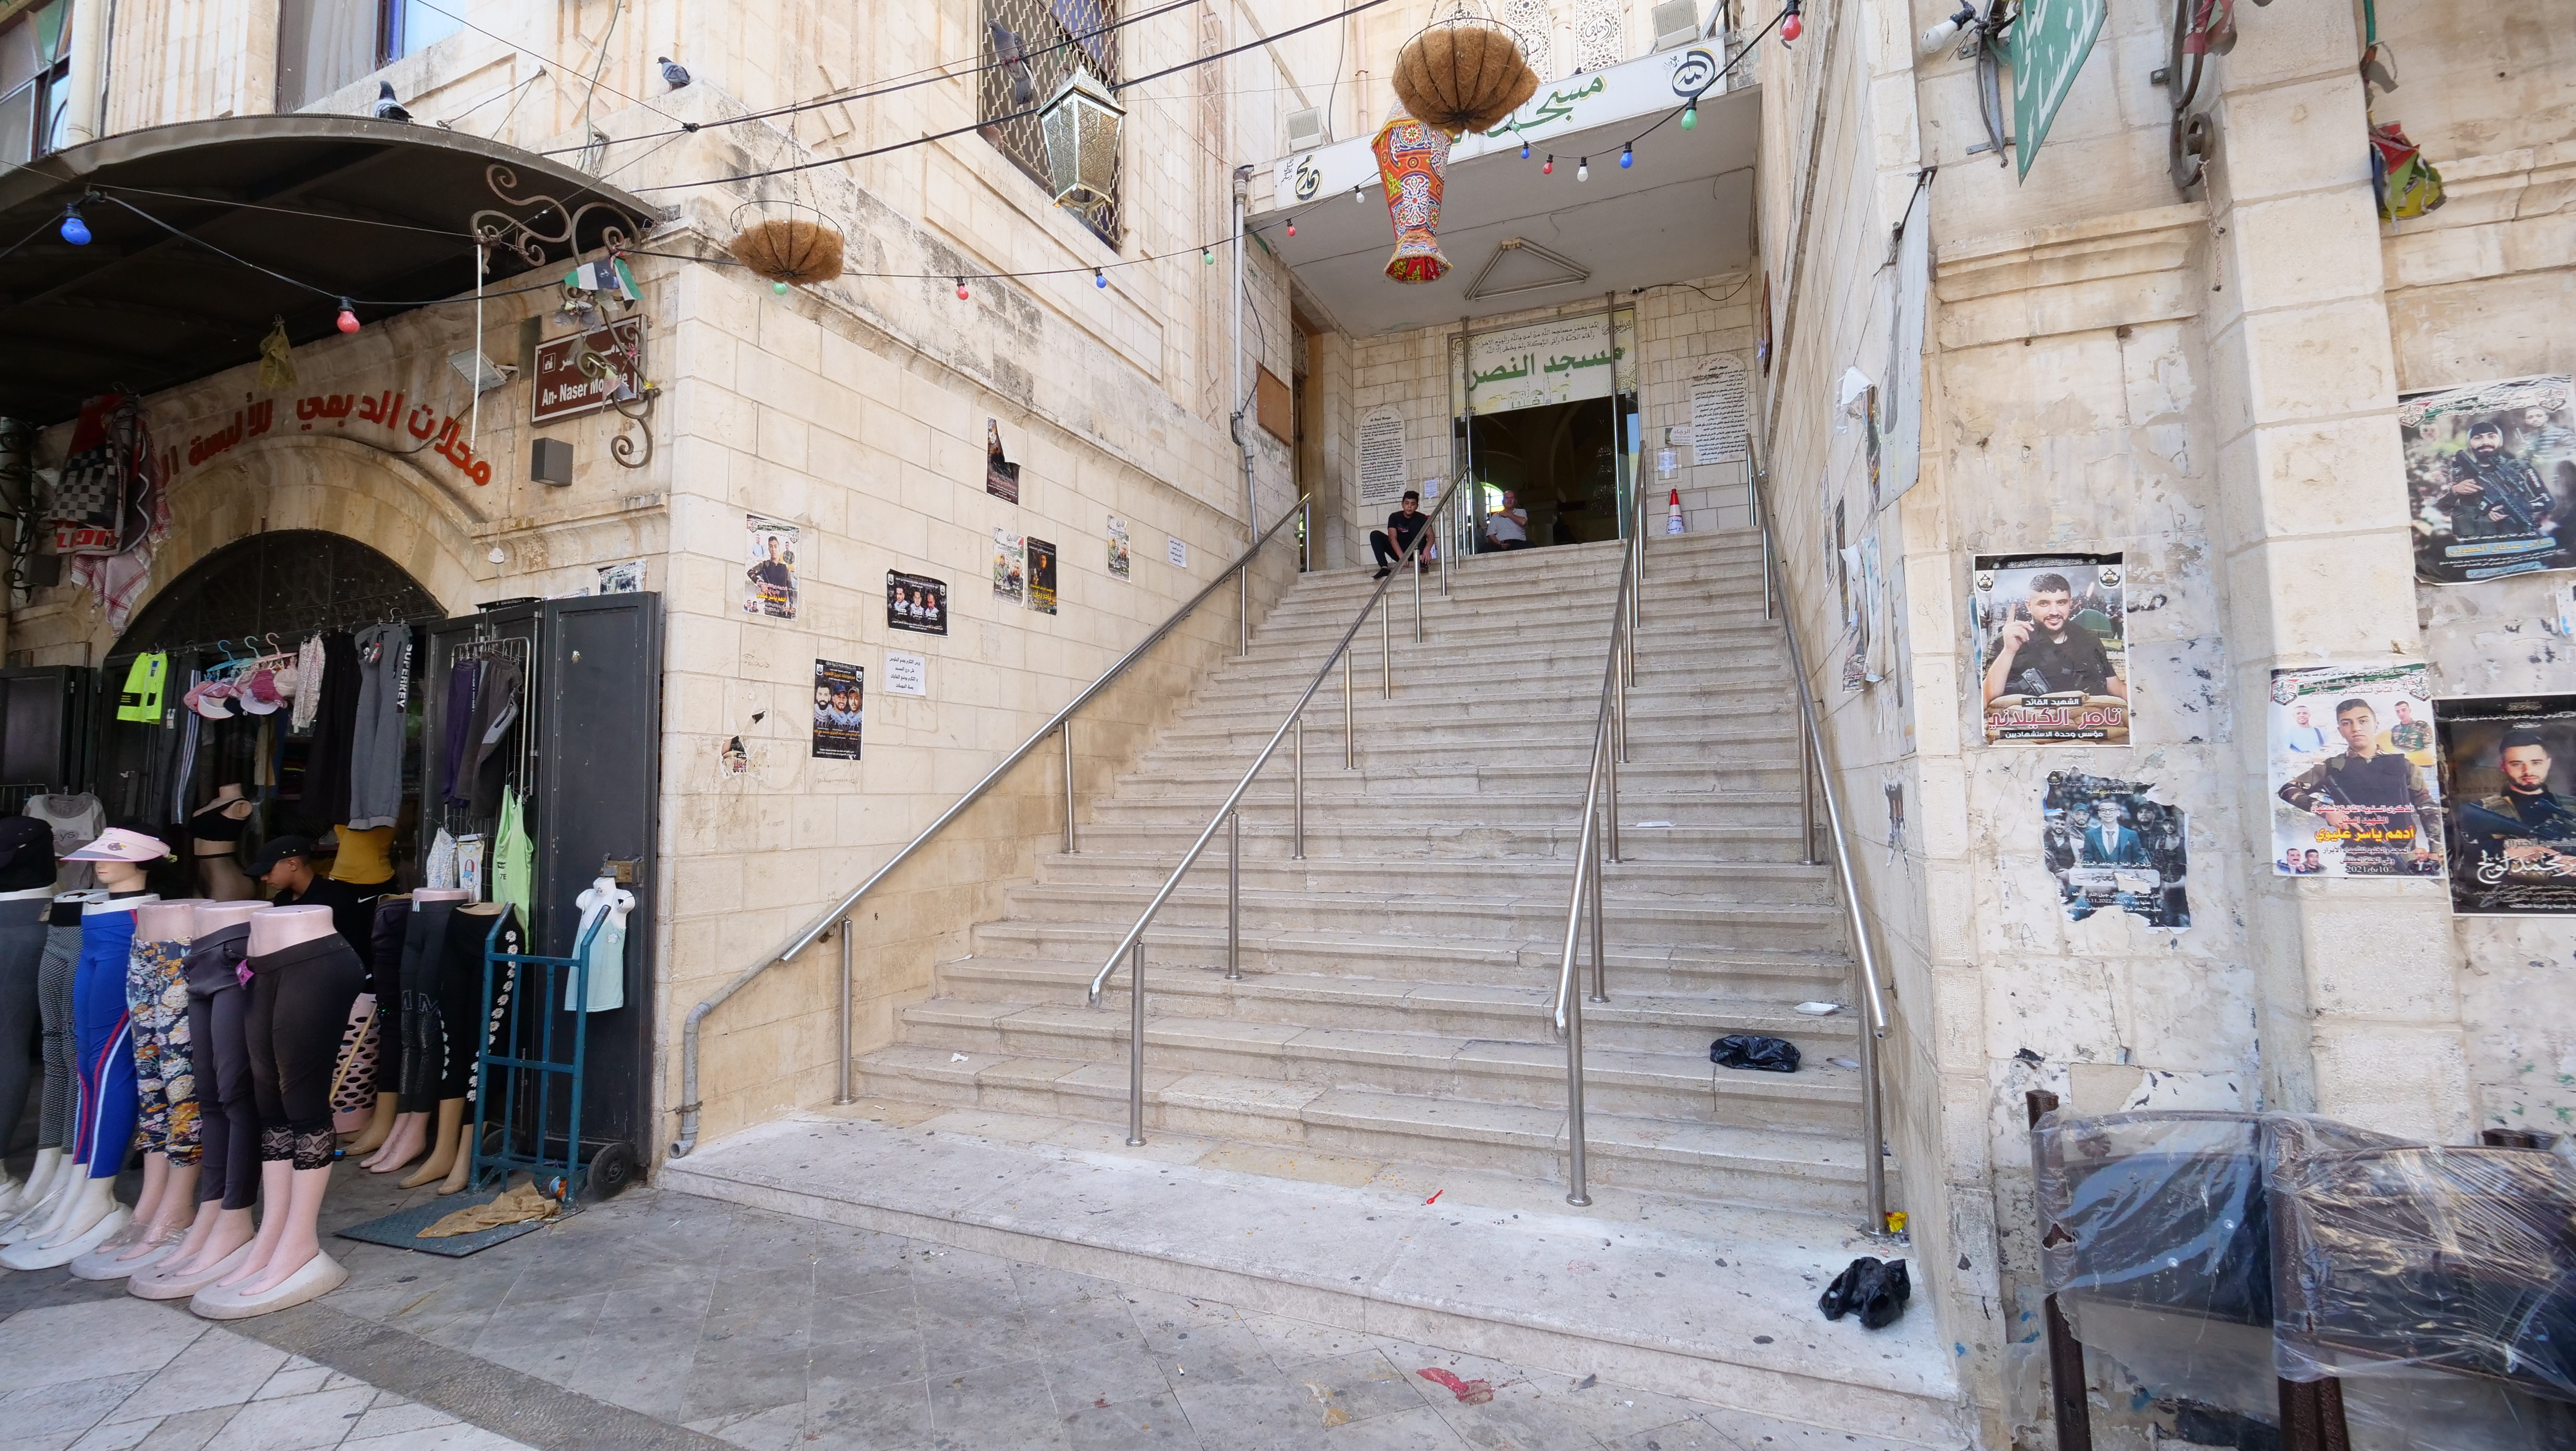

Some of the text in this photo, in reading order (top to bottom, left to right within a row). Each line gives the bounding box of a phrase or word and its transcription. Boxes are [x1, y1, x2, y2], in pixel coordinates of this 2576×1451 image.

[1464, 347, 1623, 391] مسجد النصر
[560, 384, 587, 402] Naser
[188, 392, 273, 466] للألبسة
[408, 404, 491, 486] محلات
[1033, 589, 1043, 599] ريان
[397, 643, 413, 708] SUPERKEY
[1988, 708, 2122, 730] تامر الكيلاني
[2361, 806, 2386, 814] السنوية
[2362, 816, 2389, 825] الشهيد
[2315, 826, 2415, 842] أدهم ياسر عليوي
